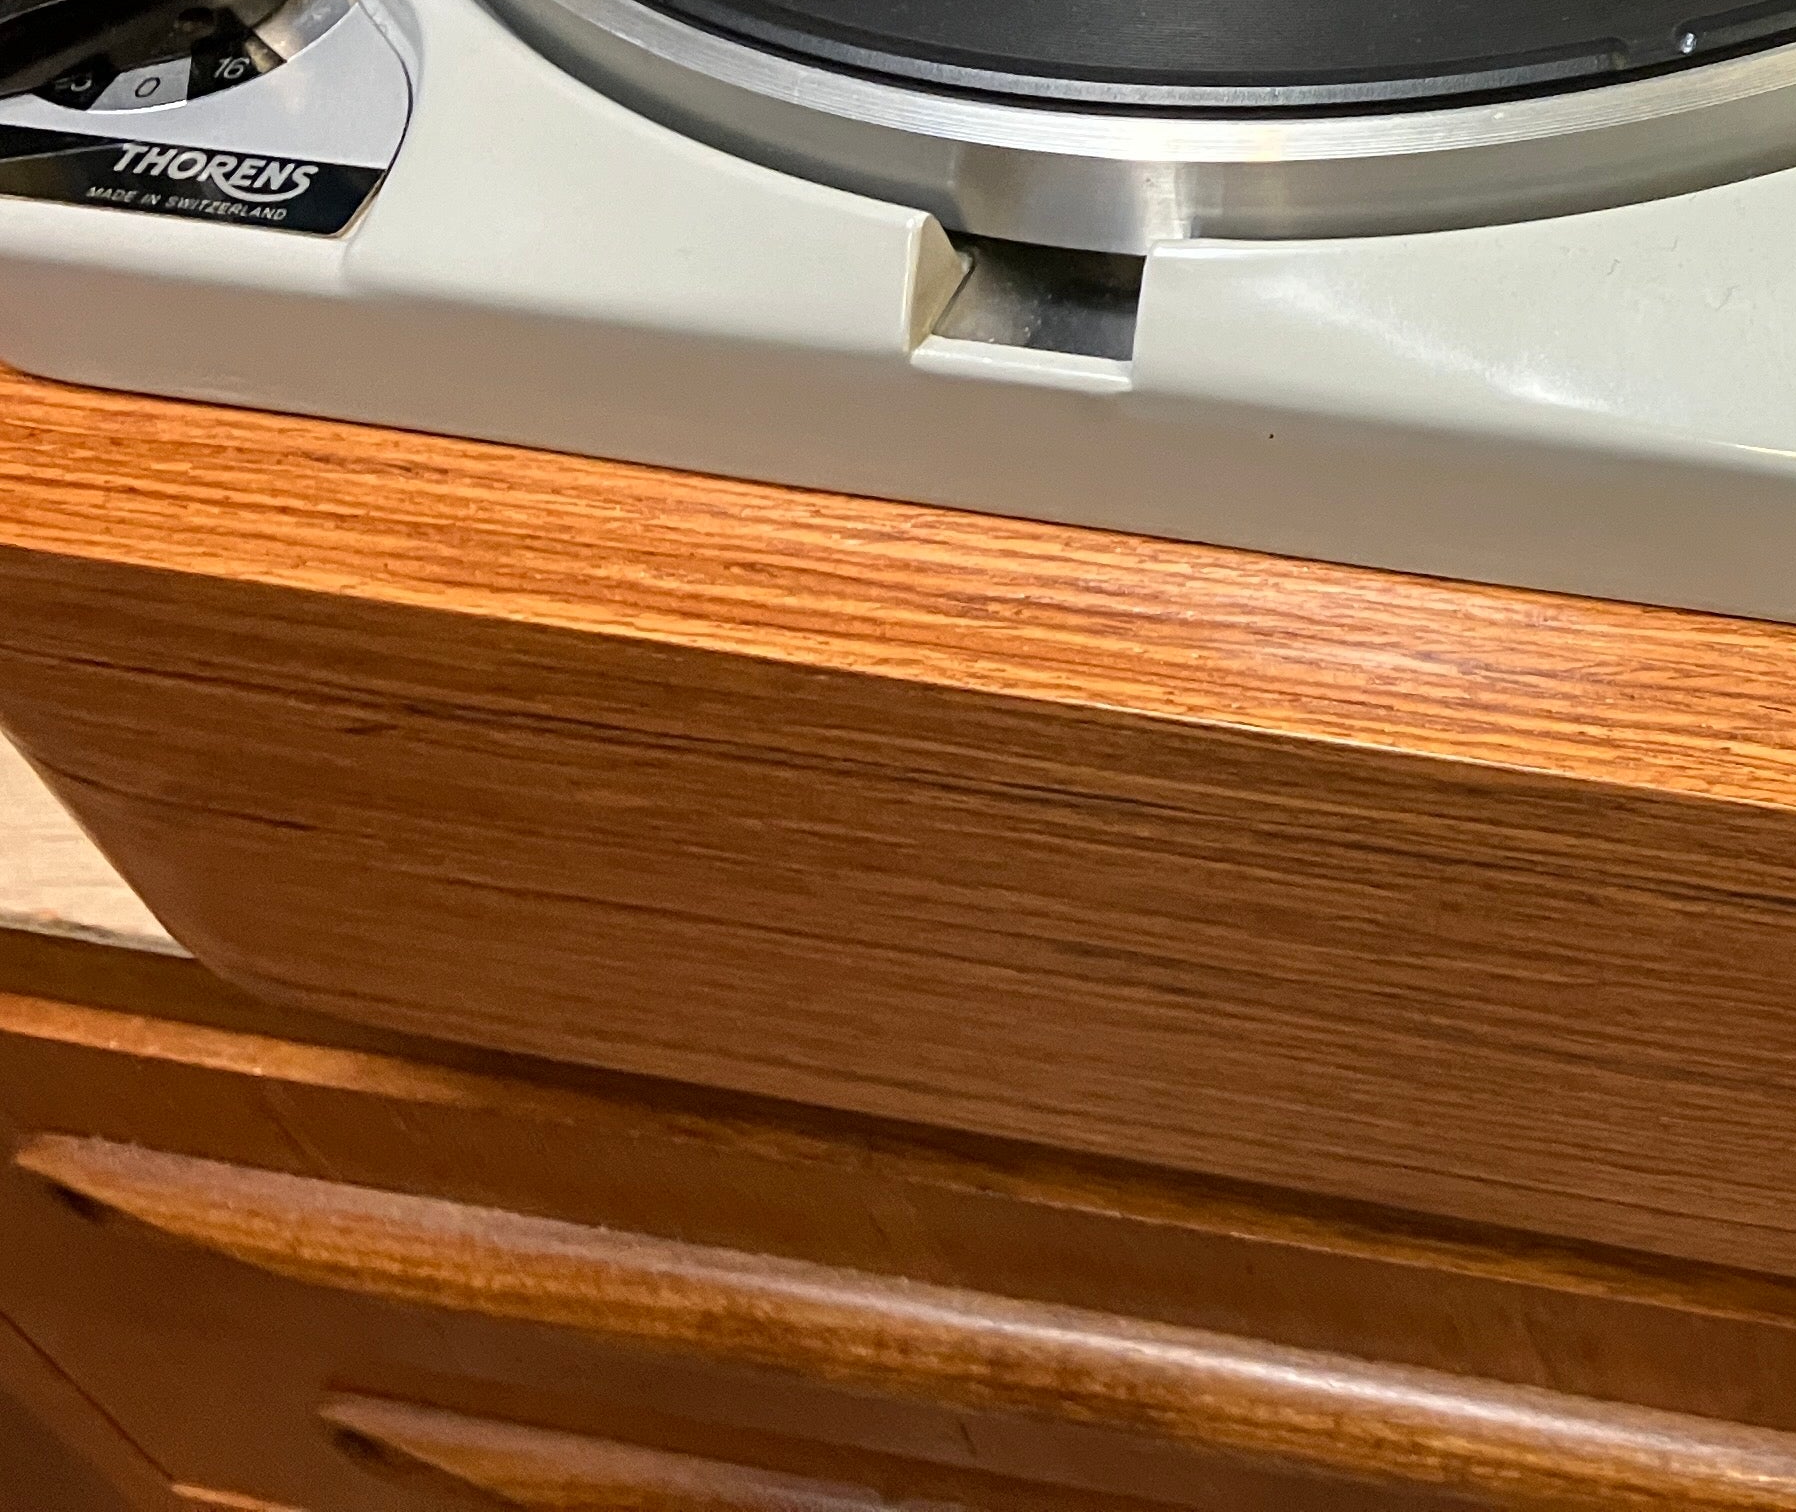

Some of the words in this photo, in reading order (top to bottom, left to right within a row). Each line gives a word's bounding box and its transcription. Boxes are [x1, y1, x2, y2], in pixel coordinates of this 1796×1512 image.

[213, 57, 250, 79] 16
[134, 76, 160, 98] 0
[113, 142, 319, 203] THORENS
[86, 186, 136, 204] MADE
[141, 193, 161, 205] IN
[165, 195, 287, 221] SWITZERLAND
